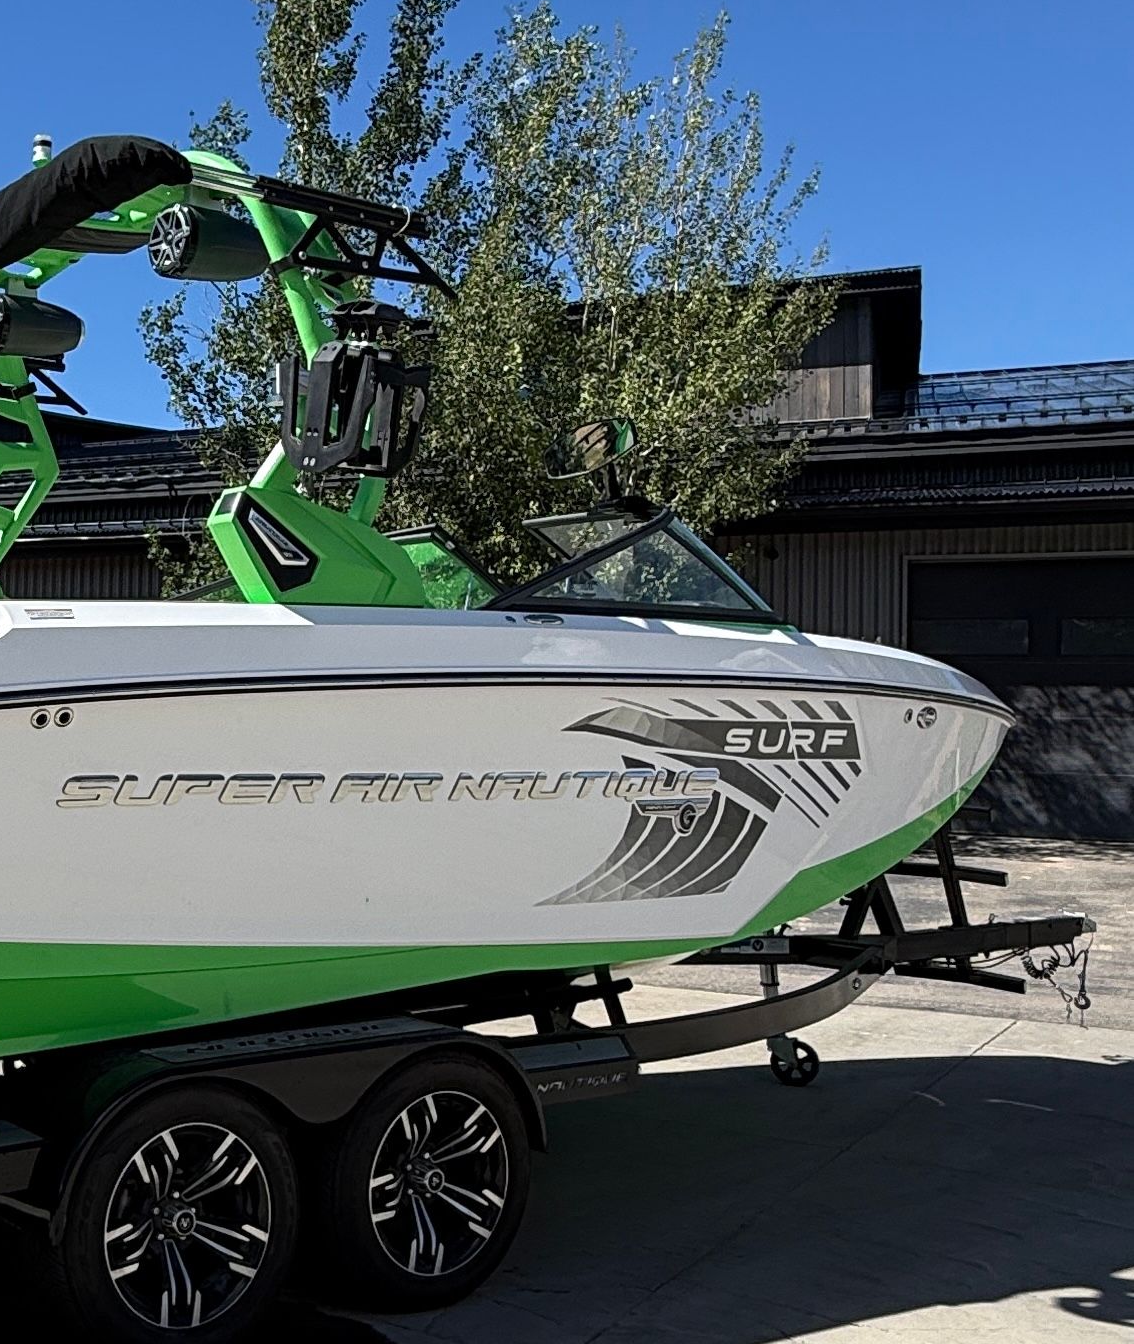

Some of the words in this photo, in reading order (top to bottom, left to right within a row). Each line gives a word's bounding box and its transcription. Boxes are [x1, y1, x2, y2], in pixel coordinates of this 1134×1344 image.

[723, 727, 848, 754] SURF
[55, 773, 326, 808] SUPER
[329, 772, 444, 803] AIR
[447, 768, 720, 801] NAUTIQUE
